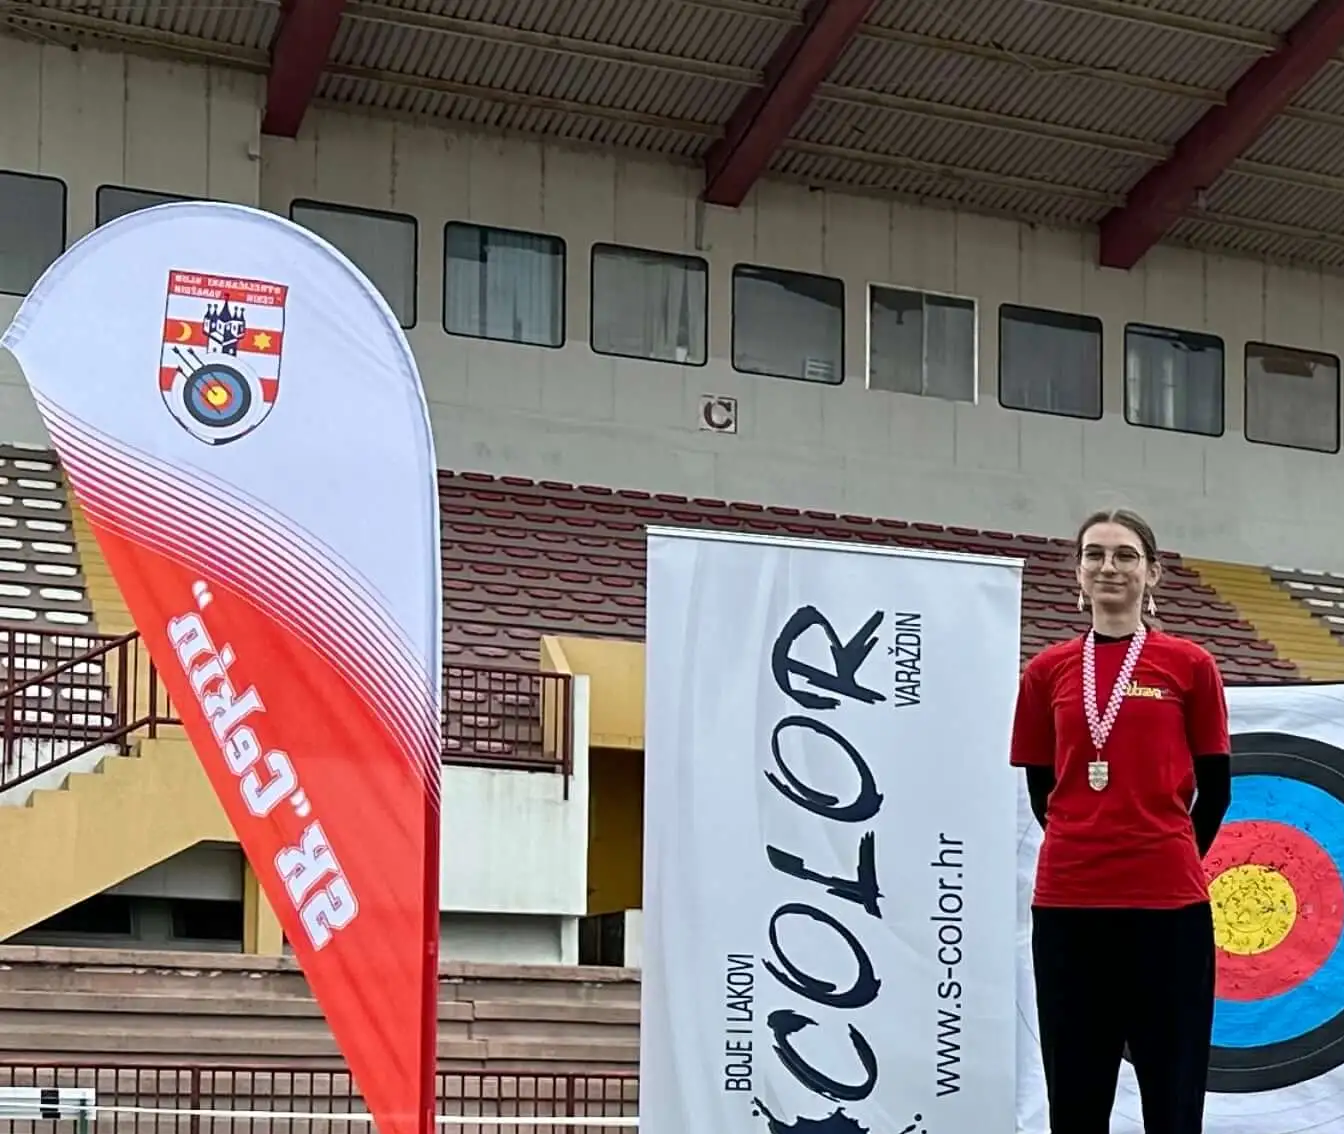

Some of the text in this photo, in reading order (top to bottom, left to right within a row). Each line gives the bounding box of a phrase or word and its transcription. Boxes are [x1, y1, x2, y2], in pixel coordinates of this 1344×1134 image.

[703, 400, 733, 430] C
[887, 612, 921, 708] VARAŽDIN
[762, 605, 887, 1103] COLOR
[726, 954, 754, 1022] LAKOVI
[930, 832, 963, 1097] www.s-color.hr
[725, 1040, 753, 1092] BOJE
